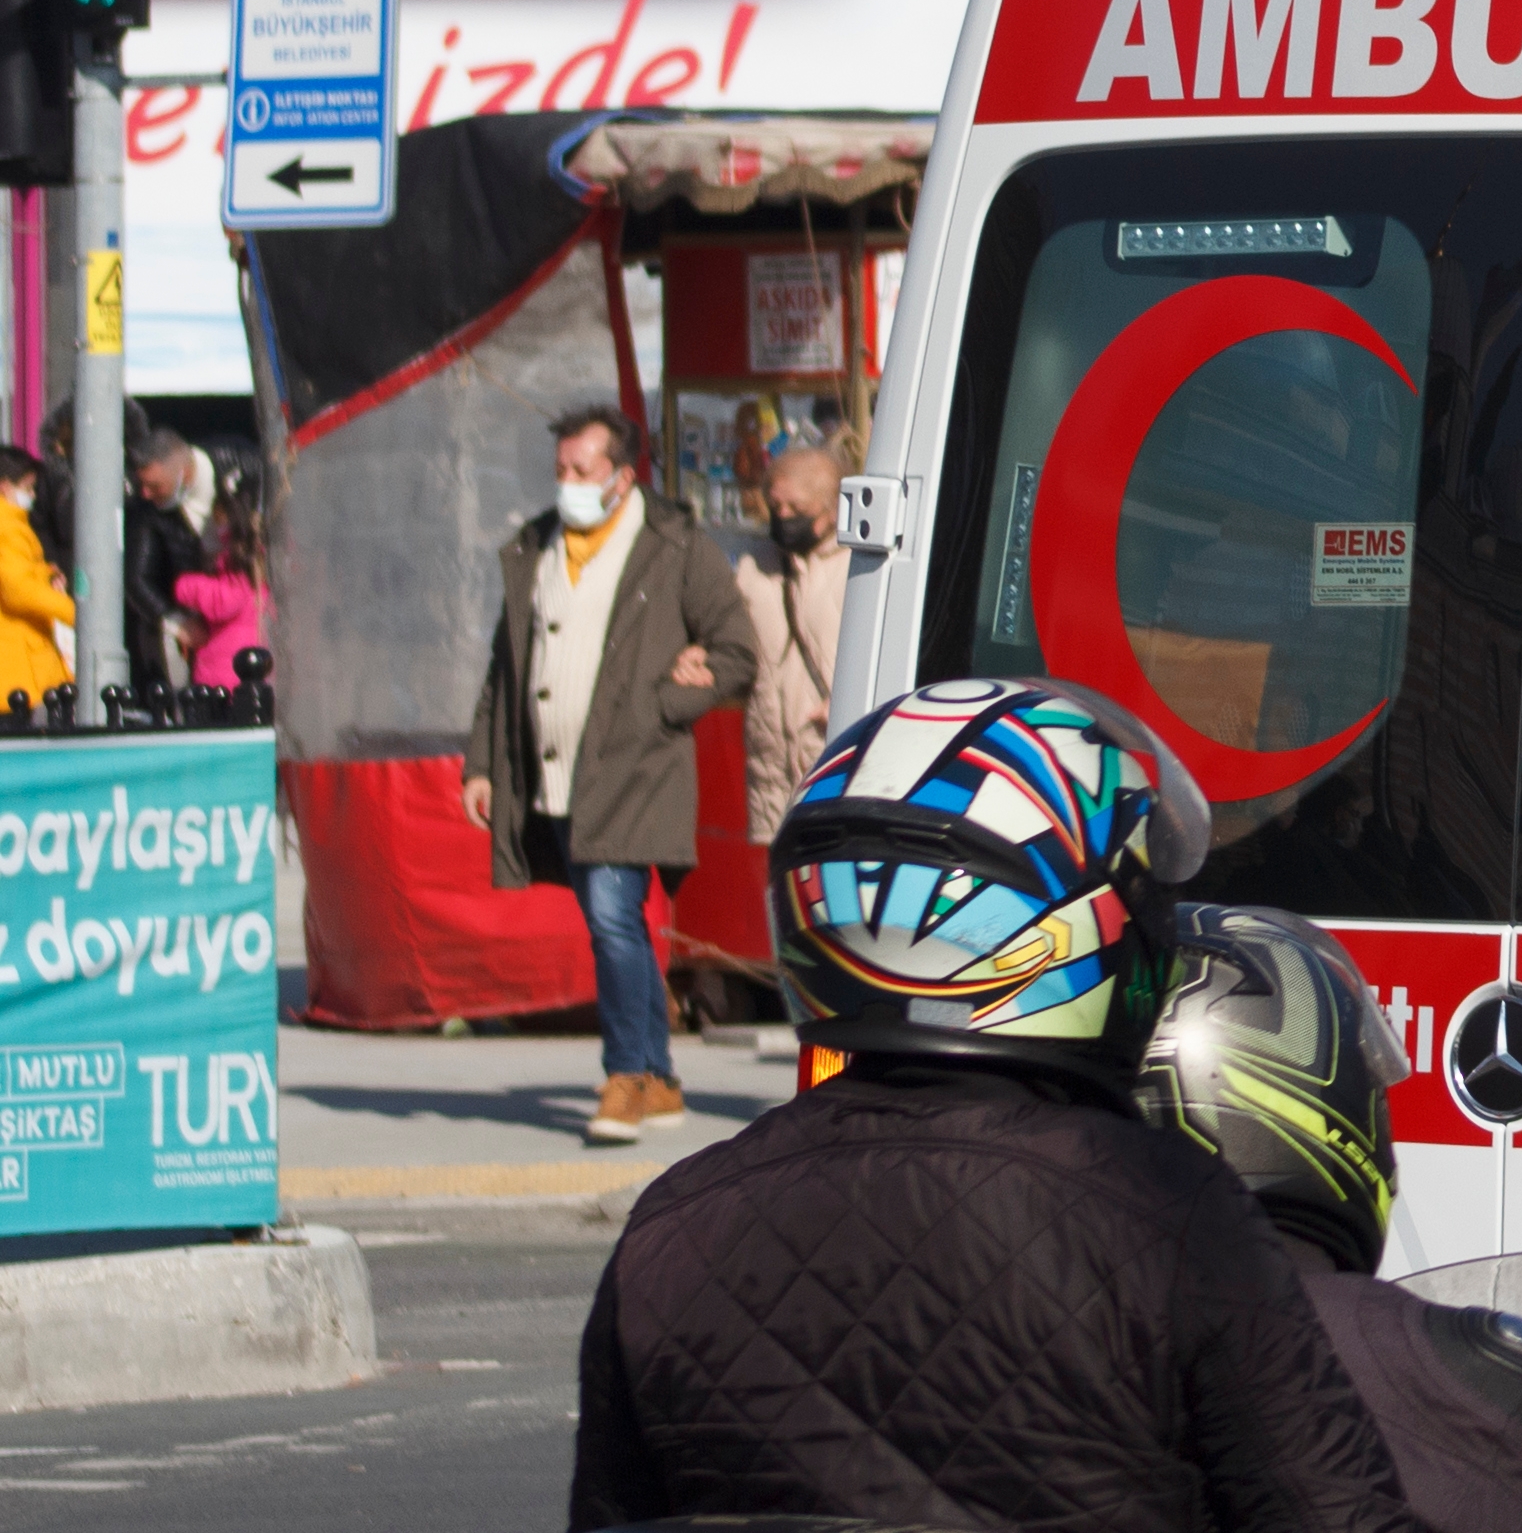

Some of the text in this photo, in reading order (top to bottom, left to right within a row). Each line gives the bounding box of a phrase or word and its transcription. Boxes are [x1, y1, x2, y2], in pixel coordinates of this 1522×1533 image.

[252, 12, 372, 38] BÜYÜKŞEHİR
[273, 41, 351, 63] BELEDİYESİ
[1348, 529, 1406, 556] EMS
[18, 1053, 116, 1089] MUTLU
